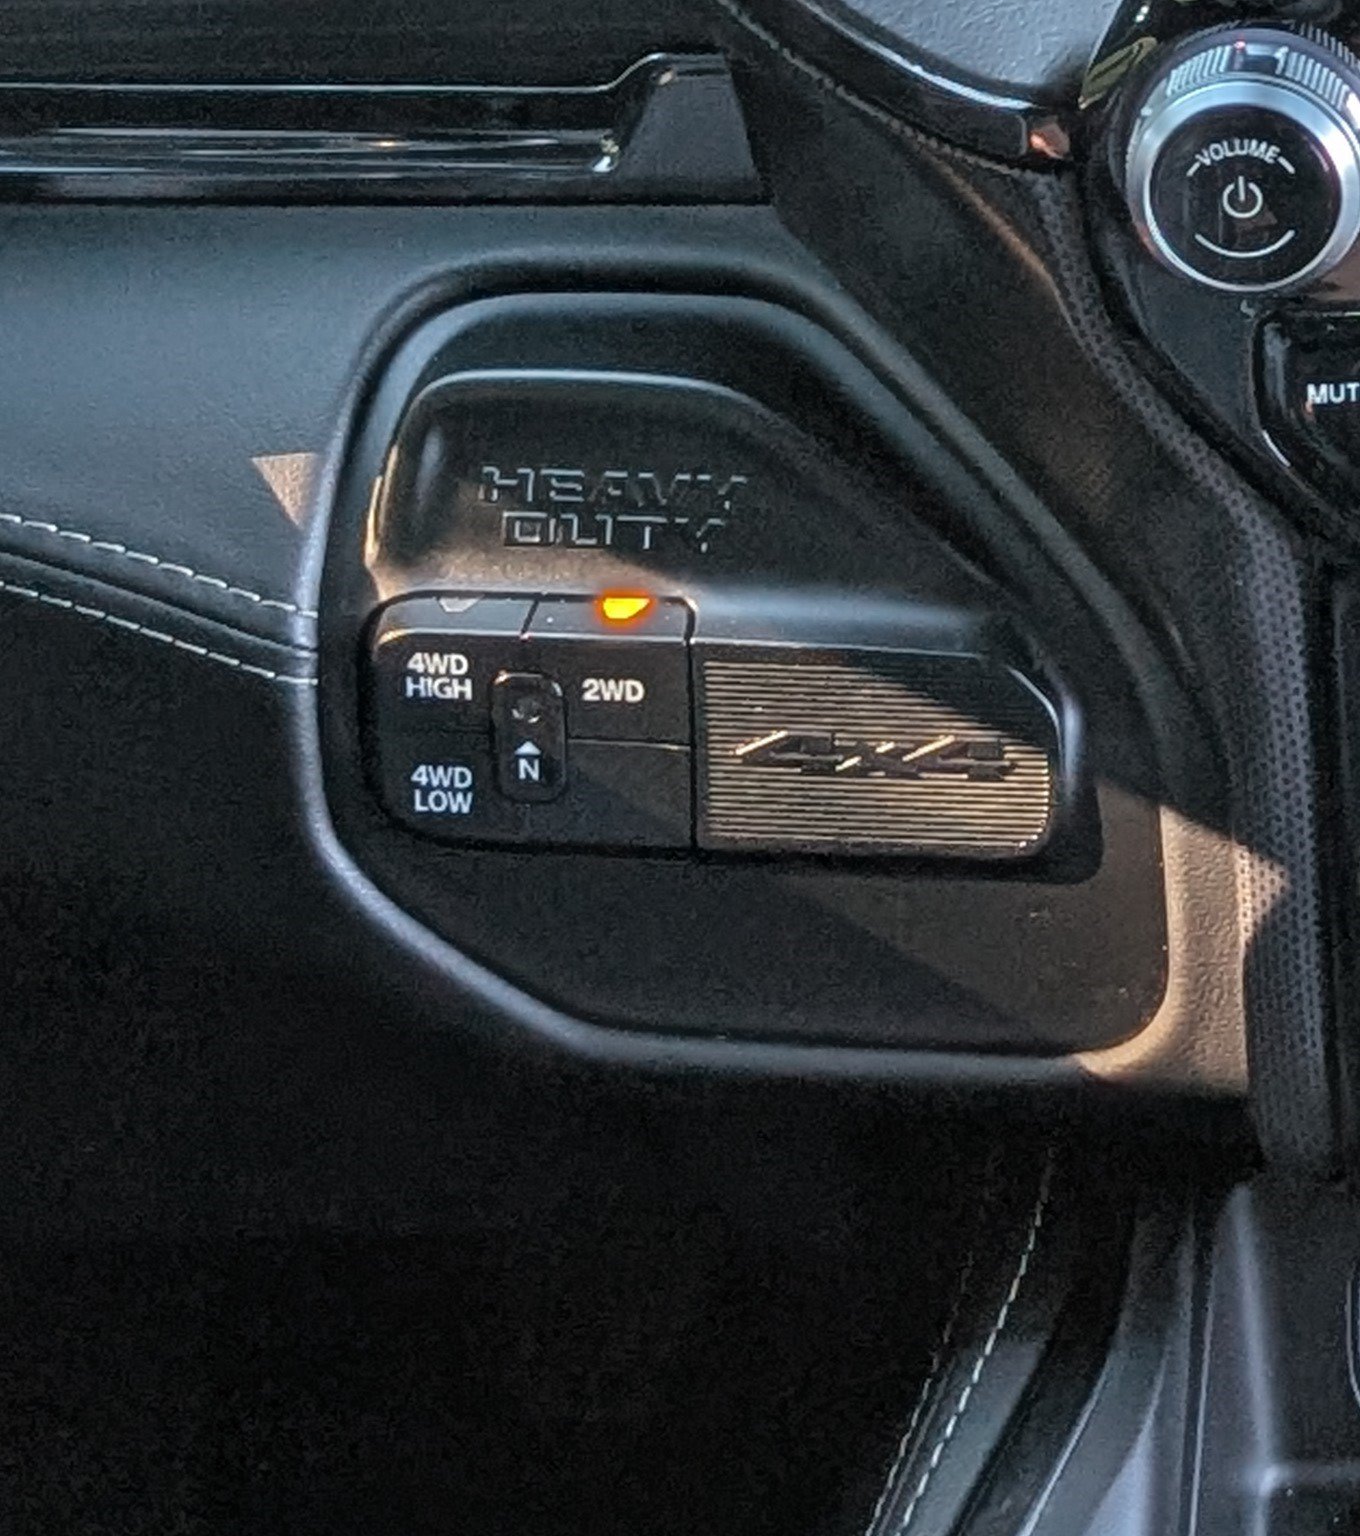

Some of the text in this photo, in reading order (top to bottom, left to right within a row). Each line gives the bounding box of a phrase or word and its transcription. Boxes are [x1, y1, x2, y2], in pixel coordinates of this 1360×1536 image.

[1195, 138, 1281, 167] VOLUME
[478, 464, 748, 509] HEAVY
[502, 511, 727, 552] DUTY
[407, 652, 469, 675] 4WD
[405, 677, 473, 701] HIGH
[581, 678, 645, 702] 2WD
[411, 765, 473, 789] 4WD
[518, 759, 540, 781] N
[414, 789, 473, 814] LOW
